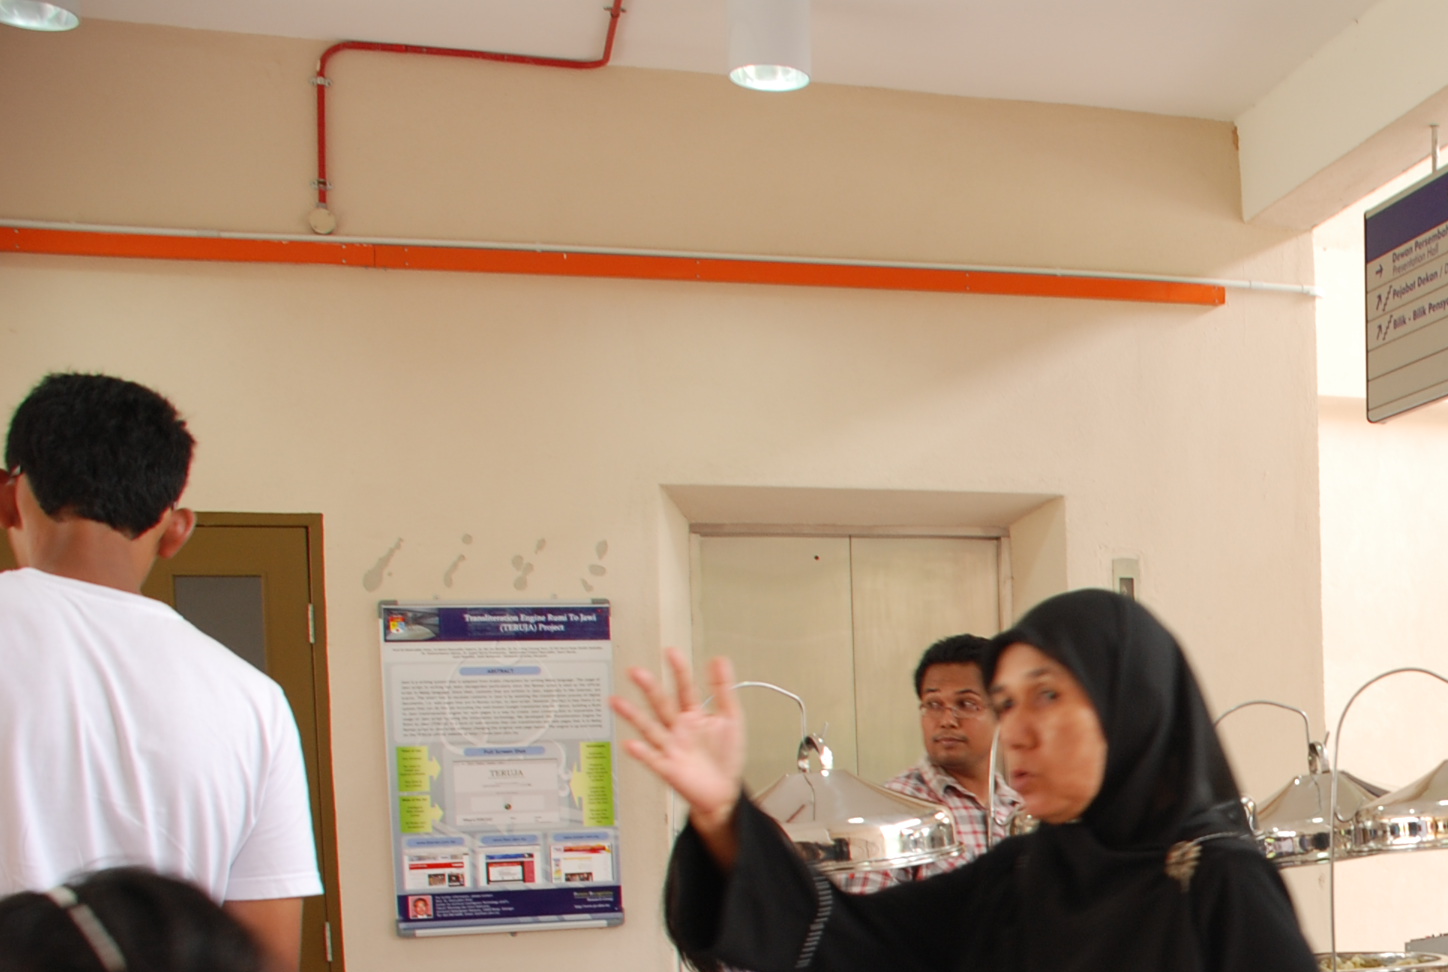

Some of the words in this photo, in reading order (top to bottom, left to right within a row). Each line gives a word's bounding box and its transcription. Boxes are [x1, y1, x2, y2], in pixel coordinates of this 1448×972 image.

[1392, 245, 1413, 263] Dewan
[1392, 276, 1416, 299] Pejabat
[1417, 269, 1438, 287] Dekan
[1393, 311, 1407, 330] Bilik
[1413, 304, 1427, 321] Bilik
[489, 769, 524, 777] TERUJA
